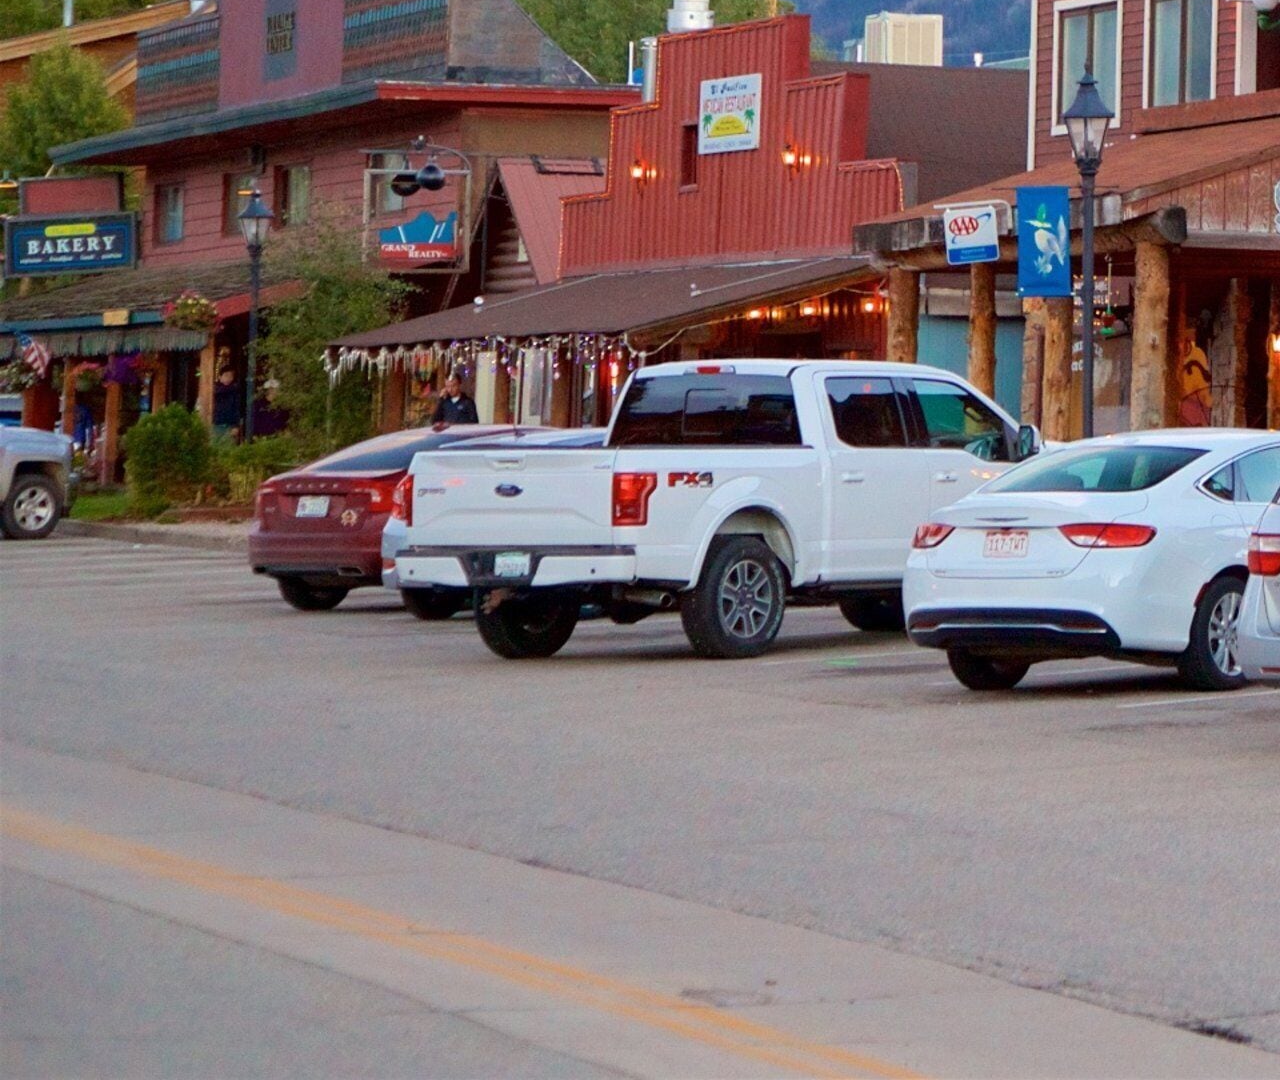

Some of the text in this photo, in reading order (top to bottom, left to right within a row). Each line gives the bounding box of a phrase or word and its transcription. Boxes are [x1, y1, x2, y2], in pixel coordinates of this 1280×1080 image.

[27, 235, 116, 255] BAKERY
[381, 244, 415, 252] GRAND
[408, 250, 441, 258] REALTY
[667, 471, 714, 488] FX4
